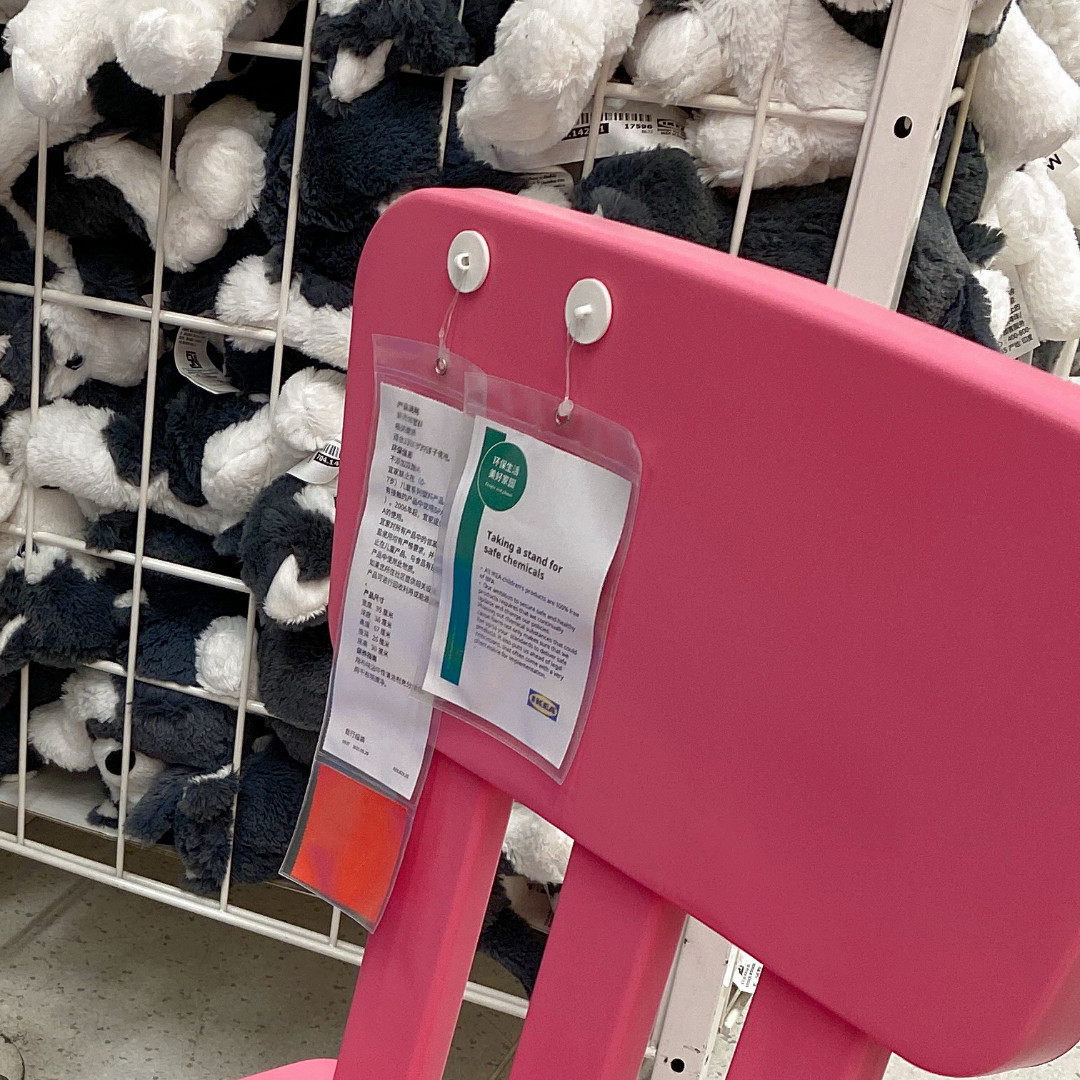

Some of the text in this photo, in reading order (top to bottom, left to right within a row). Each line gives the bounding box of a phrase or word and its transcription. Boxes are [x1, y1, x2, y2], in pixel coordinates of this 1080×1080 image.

[492, 455, 520, 476] 环保生活
[488, 468, 516, 490] 美好家园
[484, 544, 545, 581] safe chemicals
[486, 530, 564, 574] Taking a stand for
[531, 695, 556, 715] IKEA
